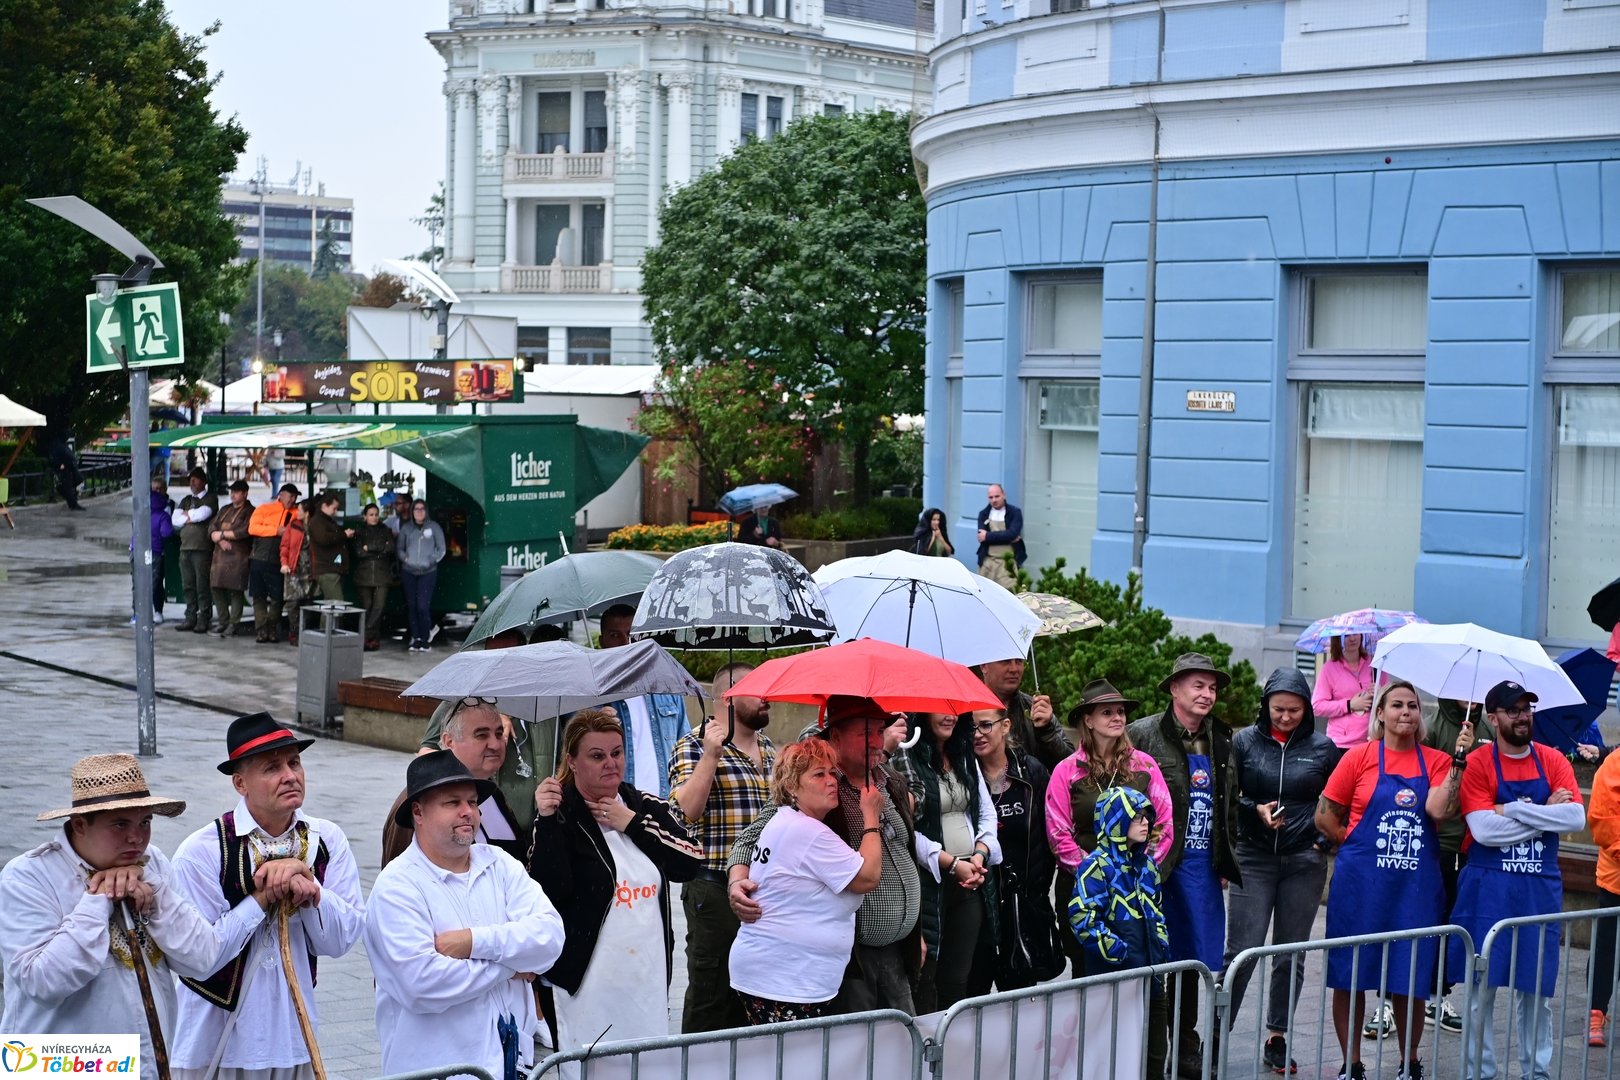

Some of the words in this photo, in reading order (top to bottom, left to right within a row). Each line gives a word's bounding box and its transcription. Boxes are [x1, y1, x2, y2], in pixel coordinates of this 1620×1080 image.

[349, 363, 419, 402] SÖR
[510, 451, 552, 487] Licher
[494, 494, 505, 502] AUS
[506, 493, 518, 502] DEM
[538, 491, 549, 500] DER
[549, 490, 566, 499] NATUR
[1376, 857, 1418, 871] NYVSC
[1502, 862, 1542, 873] NYVSC
